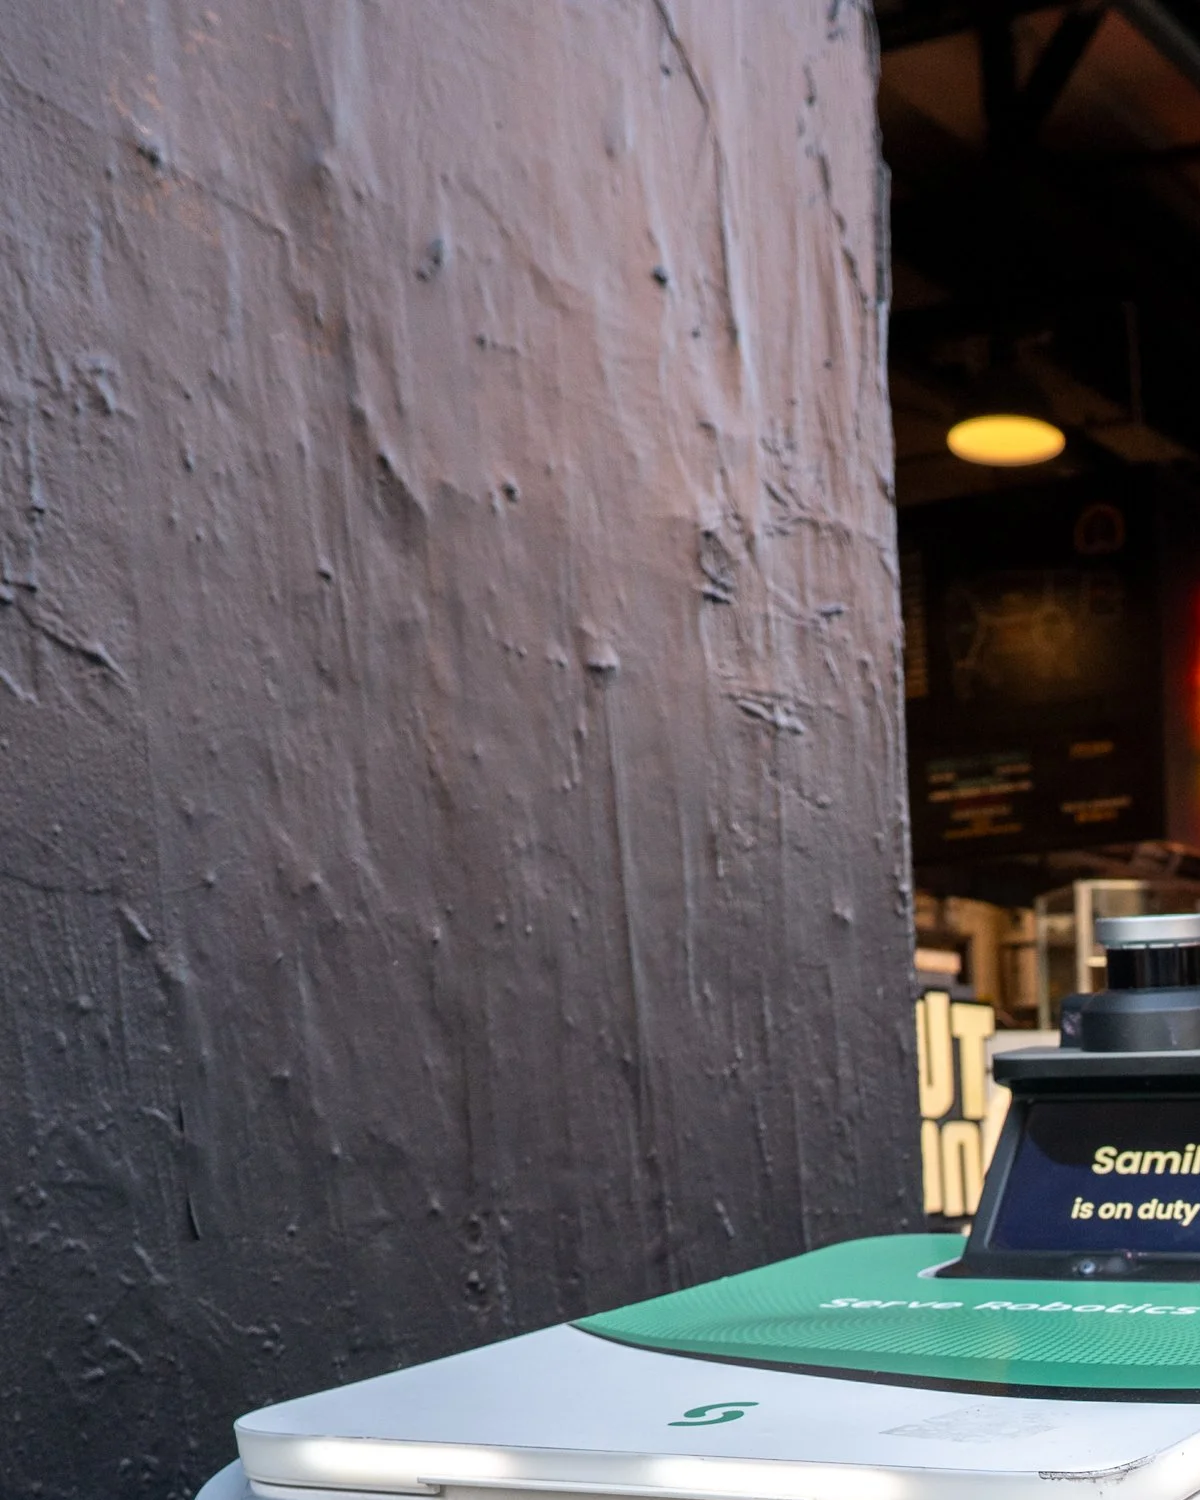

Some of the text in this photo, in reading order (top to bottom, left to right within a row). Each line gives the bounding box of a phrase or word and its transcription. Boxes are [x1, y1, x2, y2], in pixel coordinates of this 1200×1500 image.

[1071, 1196, 1095, 1220] is
[1098, 1201, 1134, 1220] on
[819, 1297, 964, 1310] Serve
